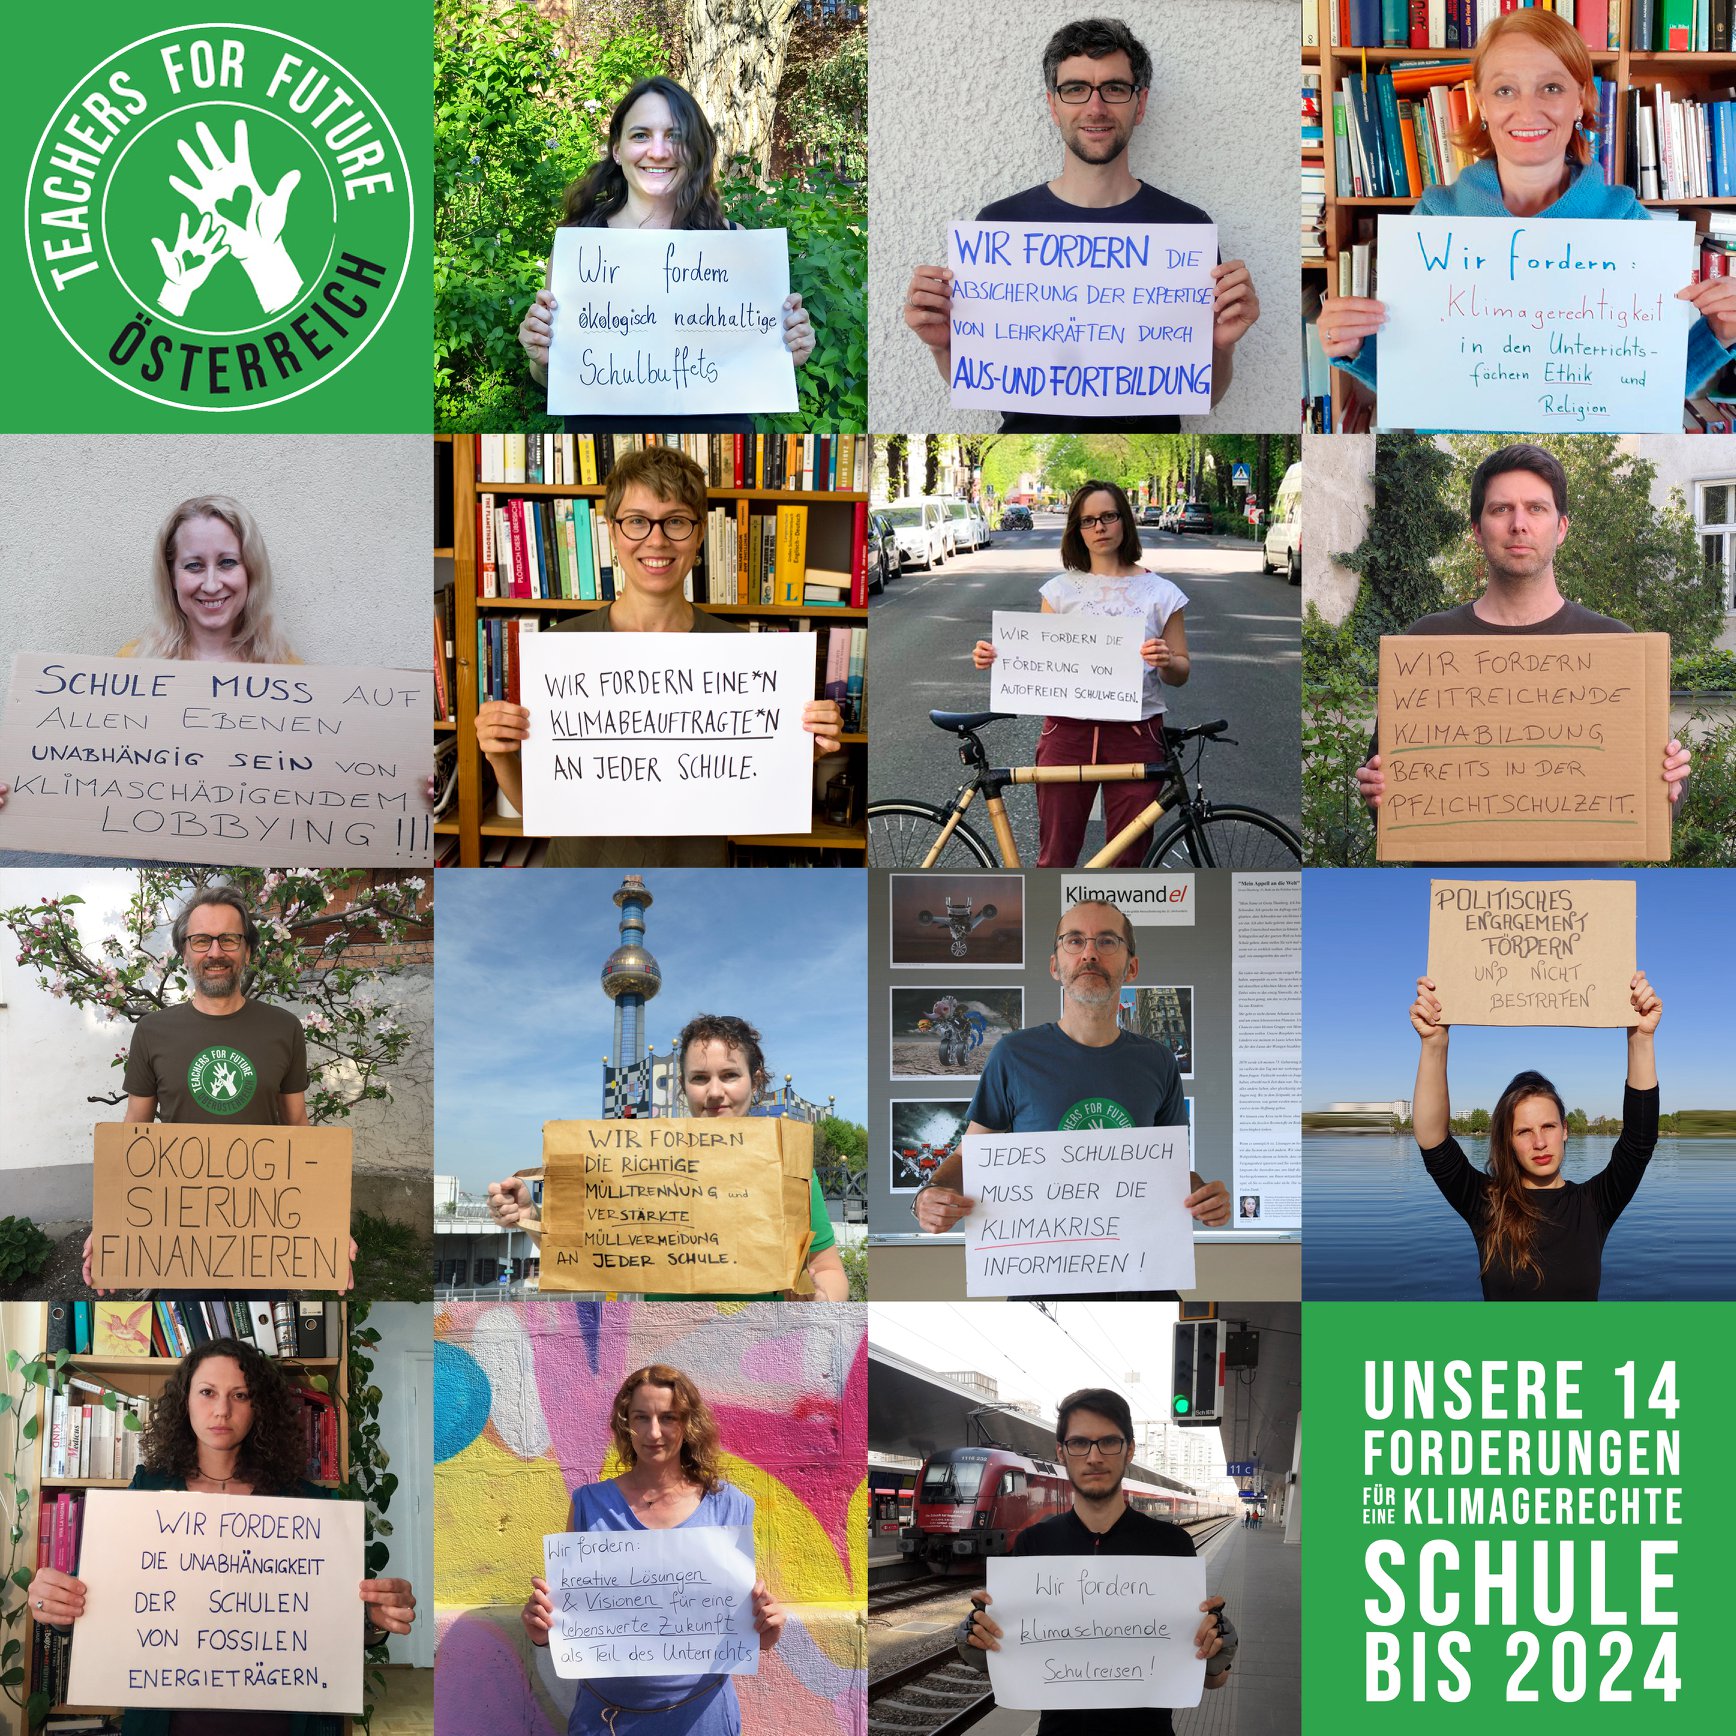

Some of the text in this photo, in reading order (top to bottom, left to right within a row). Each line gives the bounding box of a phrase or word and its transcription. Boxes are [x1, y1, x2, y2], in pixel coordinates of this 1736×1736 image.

[955, 230, 1202, 269] WIR FORDERN DIE
[1417, 232, 1486, 271] Wir
[579, 242, 729, 293] Wir fordern
[952, 280, 1214, 304] ABSICHERUNG DER EXPERTISE
[579, 303, 777, 336] ökologisch nachhaltige
[953, 317, 1192, 343] VON LEHRKRÄFTEN DURCH
[1461, 336, 1483, 355] in
[1503, 336, 1532, 354] den
[580, 347, 718, 389] Schulbuffets
[1470, 363, 1646, 387] fächern Ethik und
[1539, 395, 1608, 421] Religion
[1000, 627, 1122, 646] WIR FORDERN DIE
[1003, 656, 1113, 675] FÖRDERUNG VON
[1395, 650, 1591, 677] WIR FORDERN
[36, 665, 421, 707] SCHULE MUSS AUF
[545, 673, 589, 698] WIR
[599, 669, 693, 696] FORDERN
[1000, 684, 1139, 704] AUTOFREIEN SCHULWEGEN.
[1394, 687, 1631, 709] WEITREICHENDE
[36, 707, 342, 736] ALLEN EBENEN
[1395, 724, 1604, 745] KLIMABILDUNG
[32, 745, 397, 778] UNABHÄNGIG SEIN VON
[554, 753, 757, 782] AN JEDER SCHULE.
[1390, 760, 1585, 783] BEREITS IN DER
[14, 773, 407, 812] KLIMASCHÄDIGENDEM
[1388, 794, 1635, 821] PFLICHTSCHULZEIT.
[1066, 885, 1187, 903] Klimawandel
[1435, 888, 1572, 911] POLITISCHES
[1466, 912, 1589, 932] ENGAGEMENT
[1481, 932, 1581, 959] FÖRDERN
[1475, 960, 1582, 985] UND NICHT
[1490, 984, 1596, 1012] BESTRAFEN
[191, 1050, 253, 1093] TEACHERS FOR FUTURE
[1085, 1103, 1102, 1114] FOR
[589, 1129, 744, 1148] WIR FORDERN
[126, 1127, 318, 1180] ÖKOLOGI-
[585, 1156, 699, 1174] DIE RICHTIGE
[979, 1143, 1173, 1168] JEDES SCHULBUCH
[585, 1181, 749, 1200] MÜLLTRENNUNG und
[981, 1181, 1147, 1203] MUSS ÜBER DIE
[126, 1186, 301, 1229] SIERUNG
[588, 1208, 690, 1222] VERSTÄRKTE
[584, 1230, 718, 1246] MÜLLVERMEIDUNG
[981, 1217, 1120, 1241] KLIMAKRISE
[101, 1234, 337, 1279] FINANZIEREN
[557, 1250, 737, 1268] AN JEDER SCHULE.
[984, 1254, 1129, 1276] INFORMIEREN
[52, 1423, 60, 1448] KIND
[1230, 1465, 1240, 1474] 11
[156, 1510, 320, 1539] WIR FORDERN
[548, 1539, 570, 1560] Wir
[141, 1550, 325, 1576] DIE UNABHÄNGIGKEIT
[561, 1567, 707, 1593] kreative Lösungen
[1036, 1569, 1157, 1604] Wir fordern
[135, 1590, 309, 1613] DER SCHULEN
[562, 1592, 736, 1612] & Visionen für eine
[562, 1615, 735, 1638] lebenswerte Zukunft
[1020, 1618, 1170, 1643] klimaschonende
[136, 1628, 307, 1652] VON FOSSILEN
[561, 1641, 752, 1663] als Teil des Unterrichts
[130, 1662, 328, 1689] ENERGIETRÄGERN.
